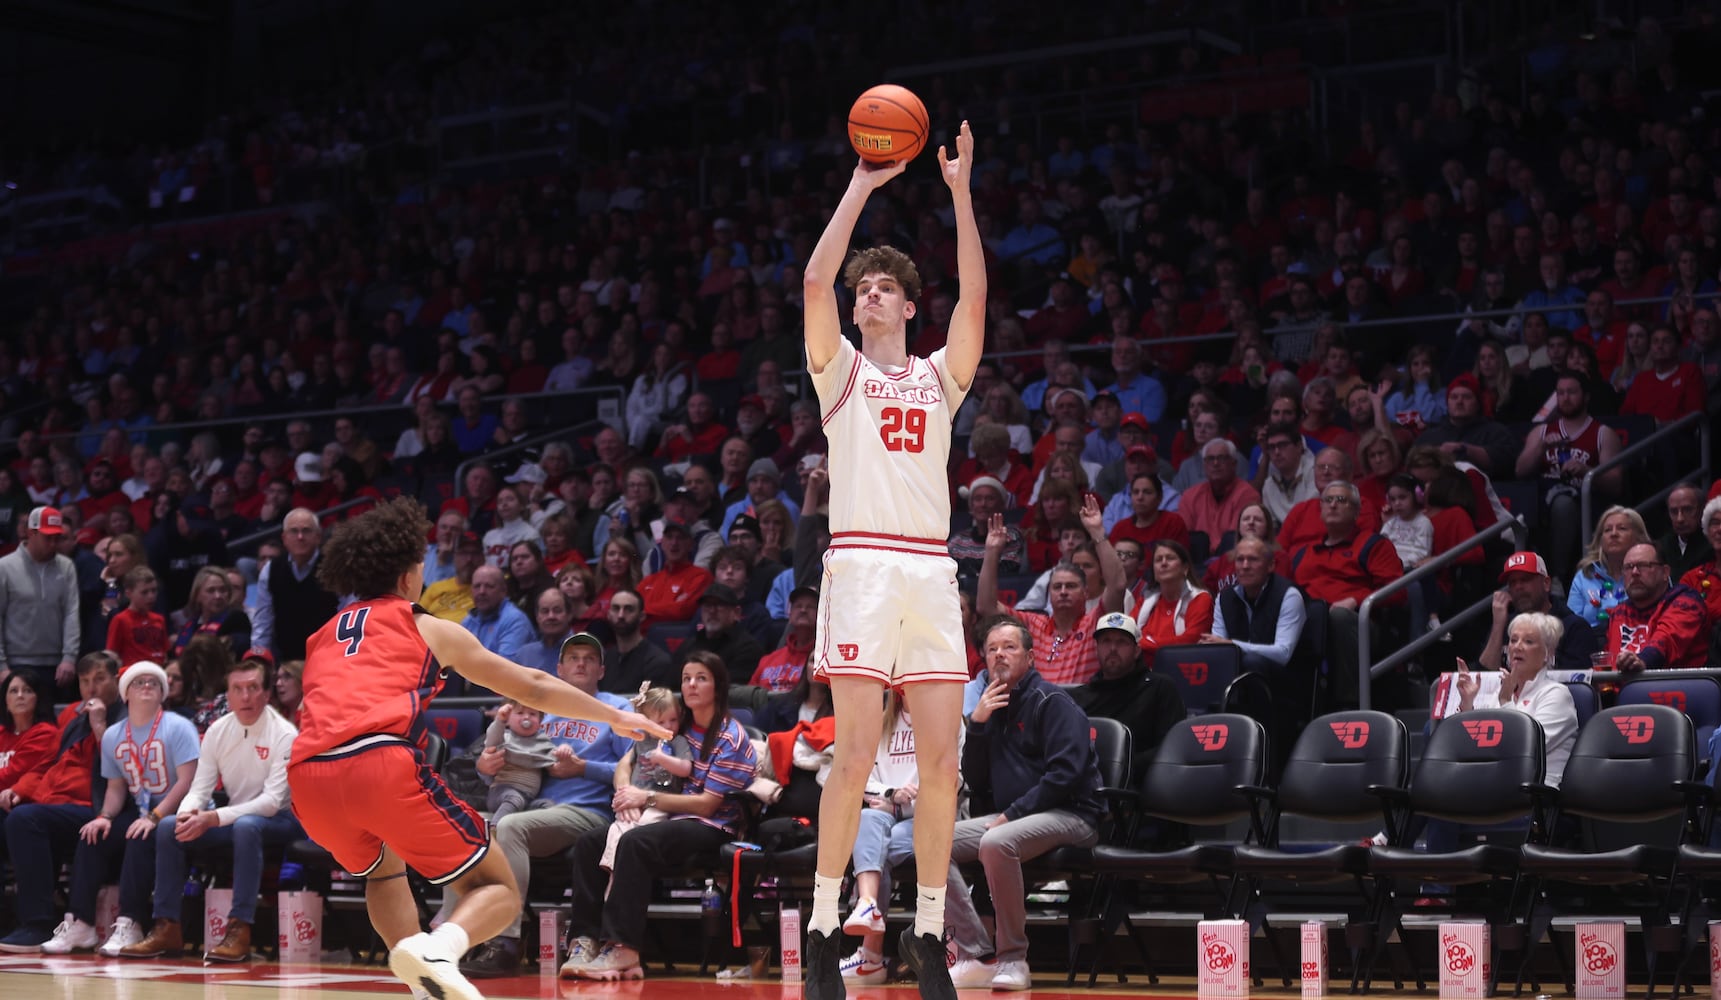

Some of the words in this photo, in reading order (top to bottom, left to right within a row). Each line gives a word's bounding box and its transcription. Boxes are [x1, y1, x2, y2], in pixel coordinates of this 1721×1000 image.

[864, 379, 941, 404] DAYTON
[880, 407, 927, 453] 29
[336, 606, 372, 657] 4
[540, 720, 600, 745] LYERS
[1191, 724, 1229, 751] D
[1330, 721, 1370, 749] D
[1461, 719, 1504, 748] D
[1612, 715, 1655, 744] D
[115, 739, 169, 795] 33
[1207, 944, 1226, 959] POP
[1209, 954, 1233, 970] CORN
[1448, 945, 1466, 960] POP
[1449, 955, 1473, 971] CORN
[1584, 945, 1607, 960] POP
[1588, 955, 1615, 971] CORN
[1302, 962, 1317, 970] POP
[1302, 971, 1319, 979] CORN
